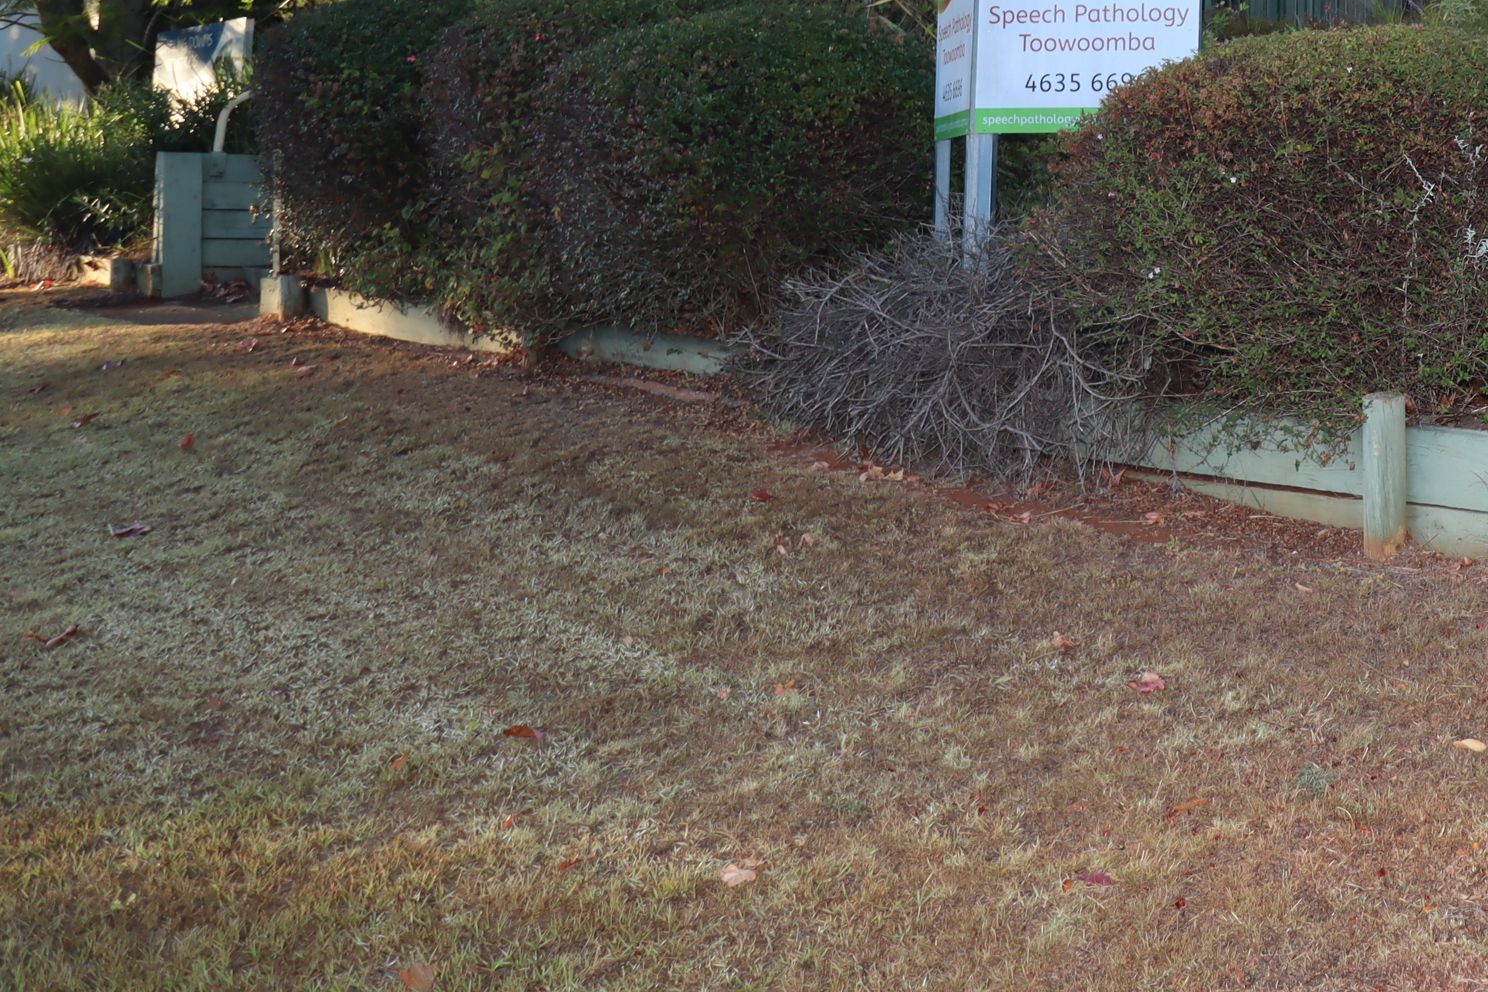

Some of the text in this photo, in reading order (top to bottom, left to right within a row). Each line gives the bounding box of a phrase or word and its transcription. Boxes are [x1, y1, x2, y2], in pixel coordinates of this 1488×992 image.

[988, 3, 1190, 28] Speech Pathology
[1018, 33, 1156, 53] Toowoomba
[1024, 72, 1147, 93] 4635 669
